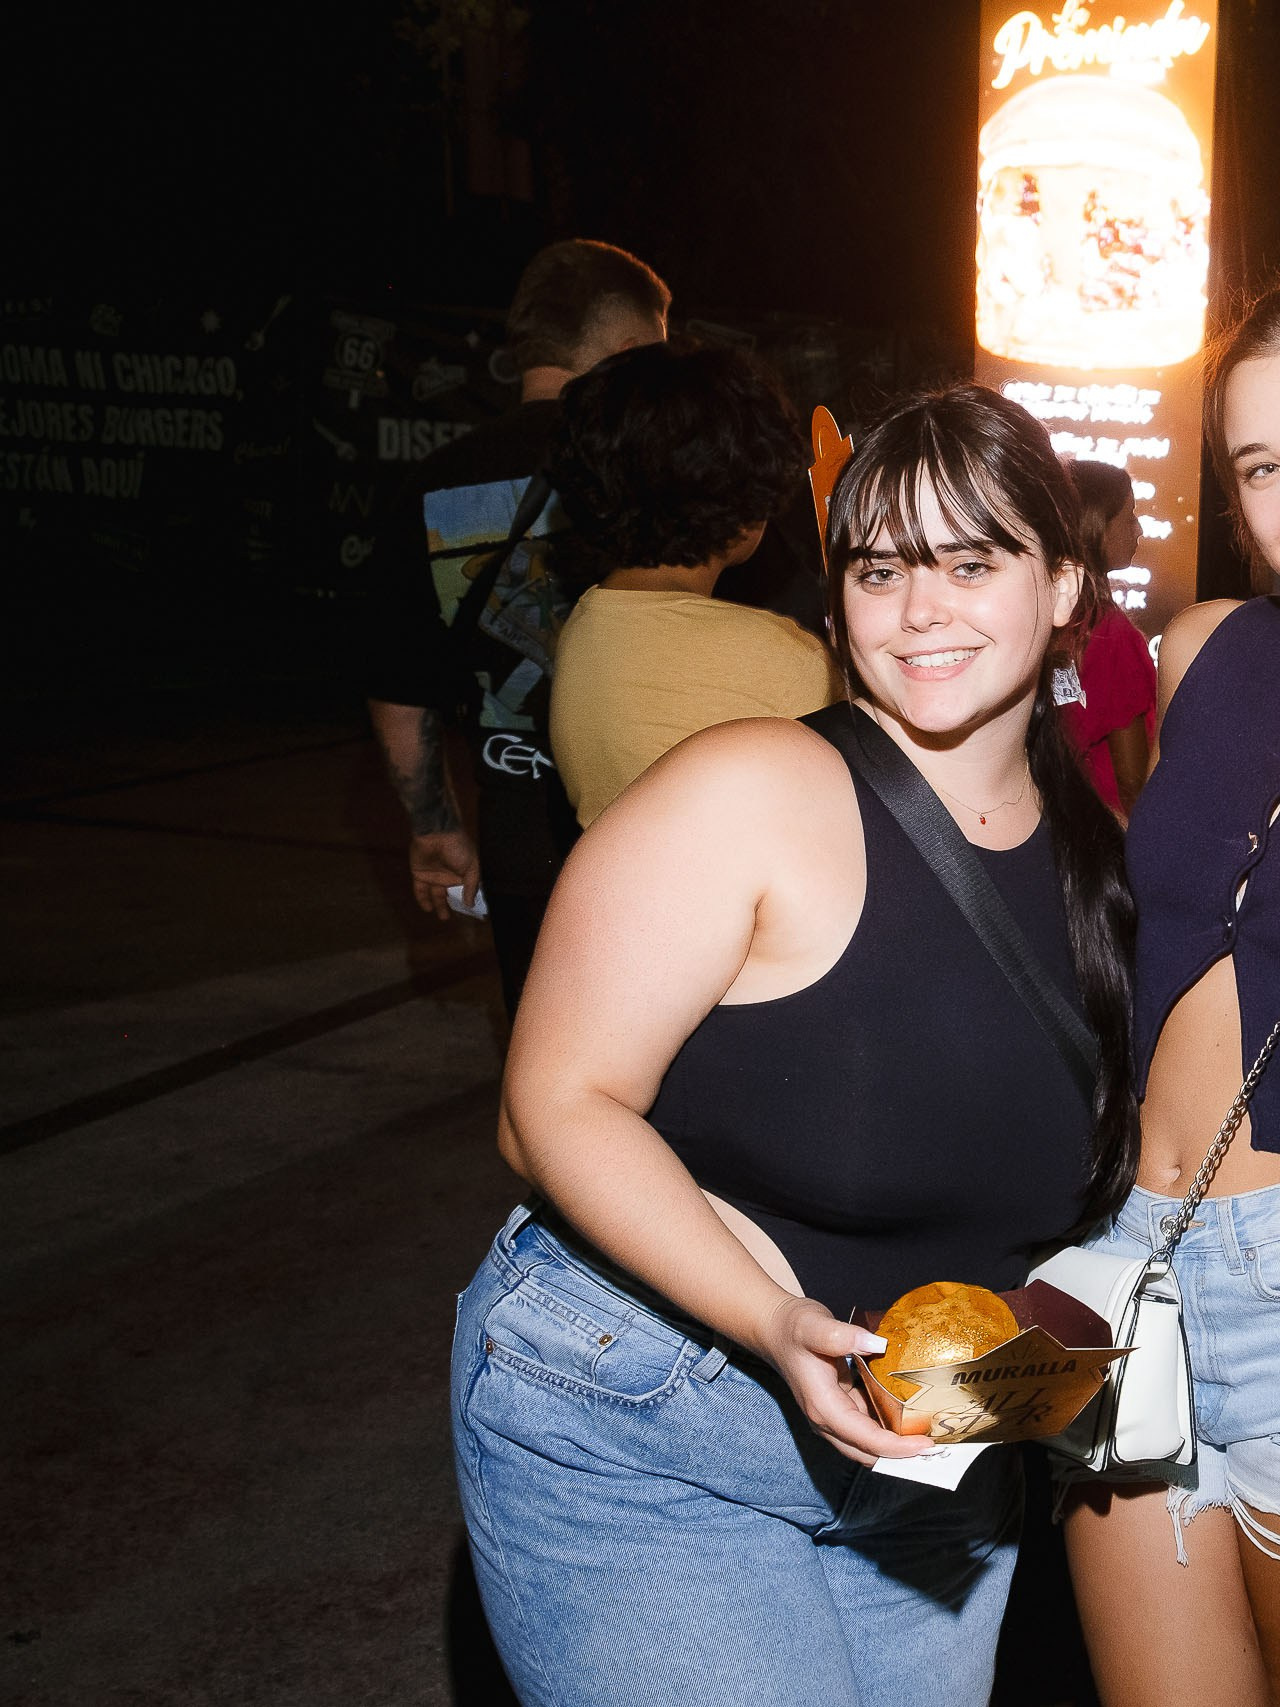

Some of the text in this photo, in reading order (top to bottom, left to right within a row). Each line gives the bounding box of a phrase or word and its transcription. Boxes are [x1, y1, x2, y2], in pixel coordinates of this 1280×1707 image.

[0, 343, 244, 402] OMA NI CHICAGO,
[101, 405, 225, 452] BURGERS
[950, 1359, 1077, 1386] MURALLA
